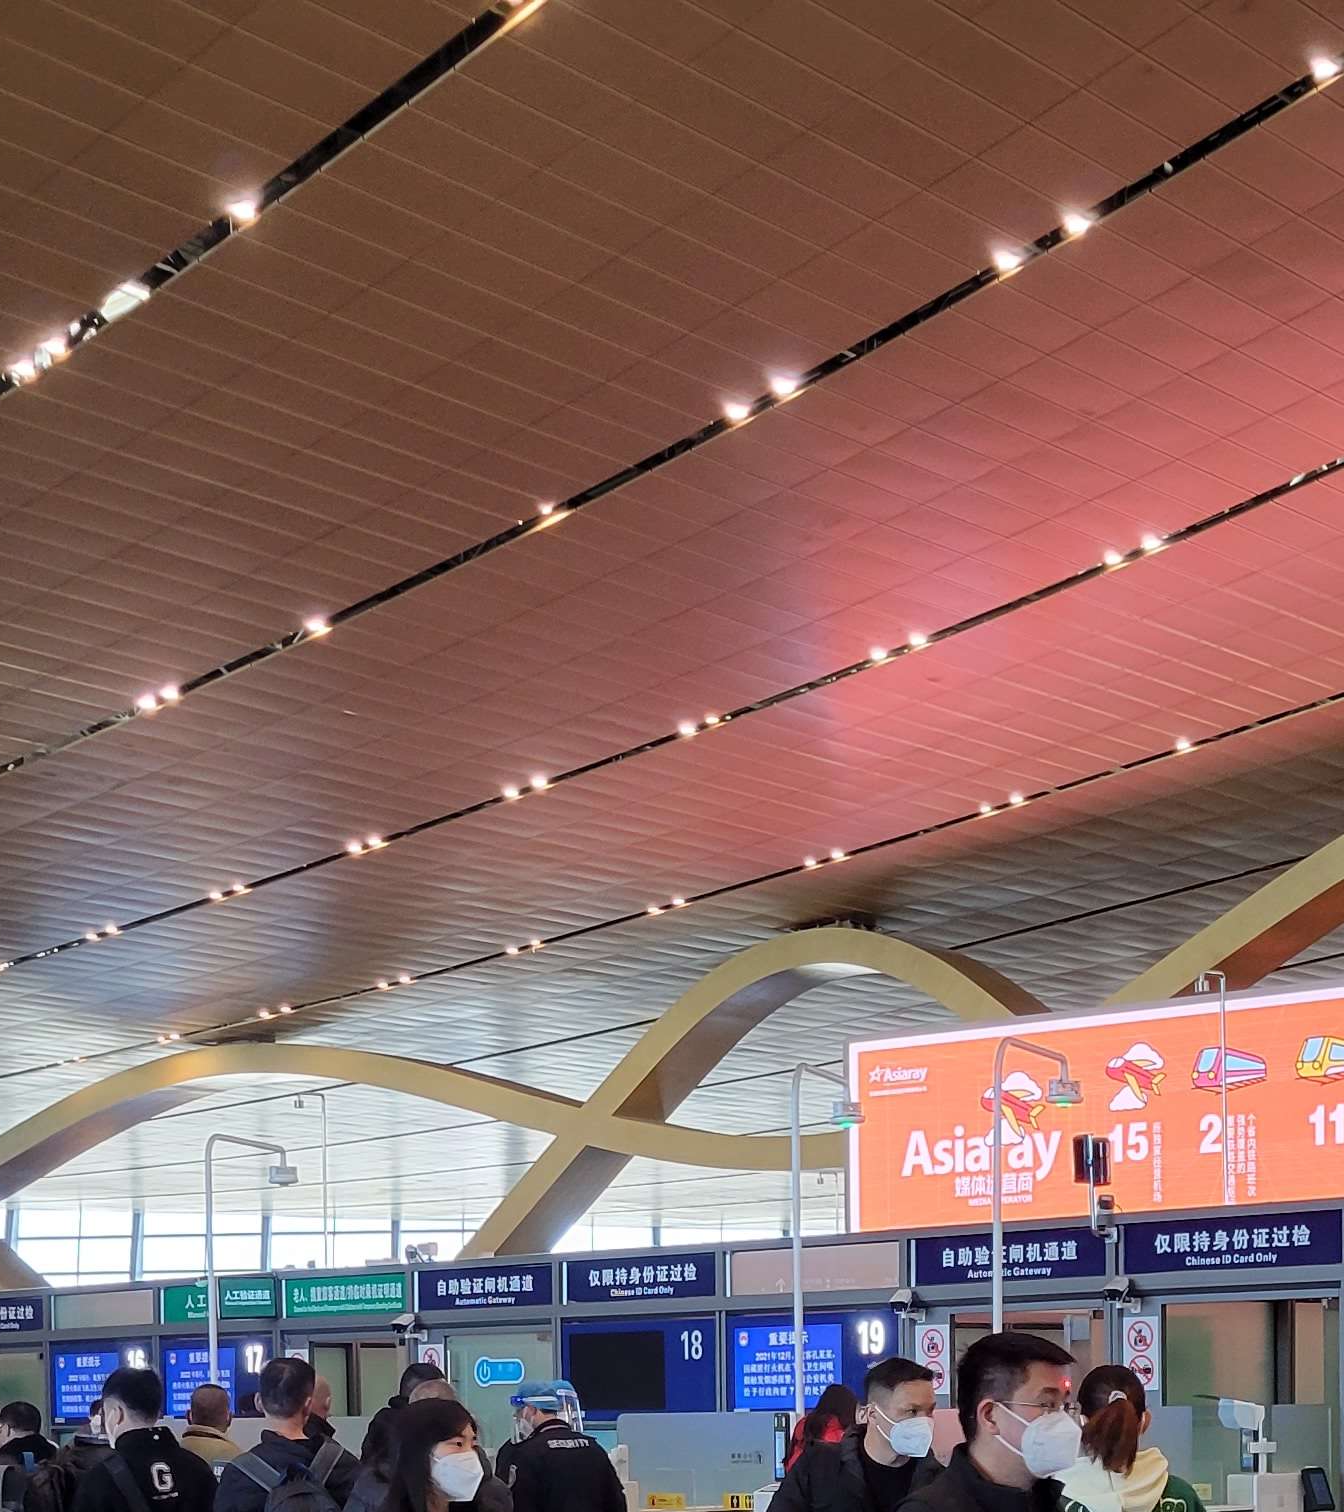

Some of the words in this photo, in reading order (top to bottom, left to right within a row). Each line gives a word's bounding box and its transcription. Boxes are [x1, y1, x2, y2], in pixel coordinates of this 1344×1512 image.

[1199, 1114, 1222, 1153] 2
[1308, 1103, 1344, 1145] 11
[901, 1125, 1062, 1181] Asiaay
[1109, 1122, 1149, 1163] 15
[1154, 1225, 1311, 1255] 仅限持身份证过检
[1013, 1267, 1052, 1278] Gateway
[1185, 1255, 1220, 1267] Chinese
[1222, 1254, 1232, 1264] ID
[1233, 1253, 1255, 1264] Card
[1256, 1251, 1278, 1264] Only
[437, 1275, 533, 1297] 自助验证闸机通道
[589, 1263, 697, 1287] 仅限持身份证过检
[681, 1330, 703, 1360] 18
[858, 1319, 885, 1356] 19
[127, 1349, 145, 1369] 16
[245, 1345, 264, 1374] 17
